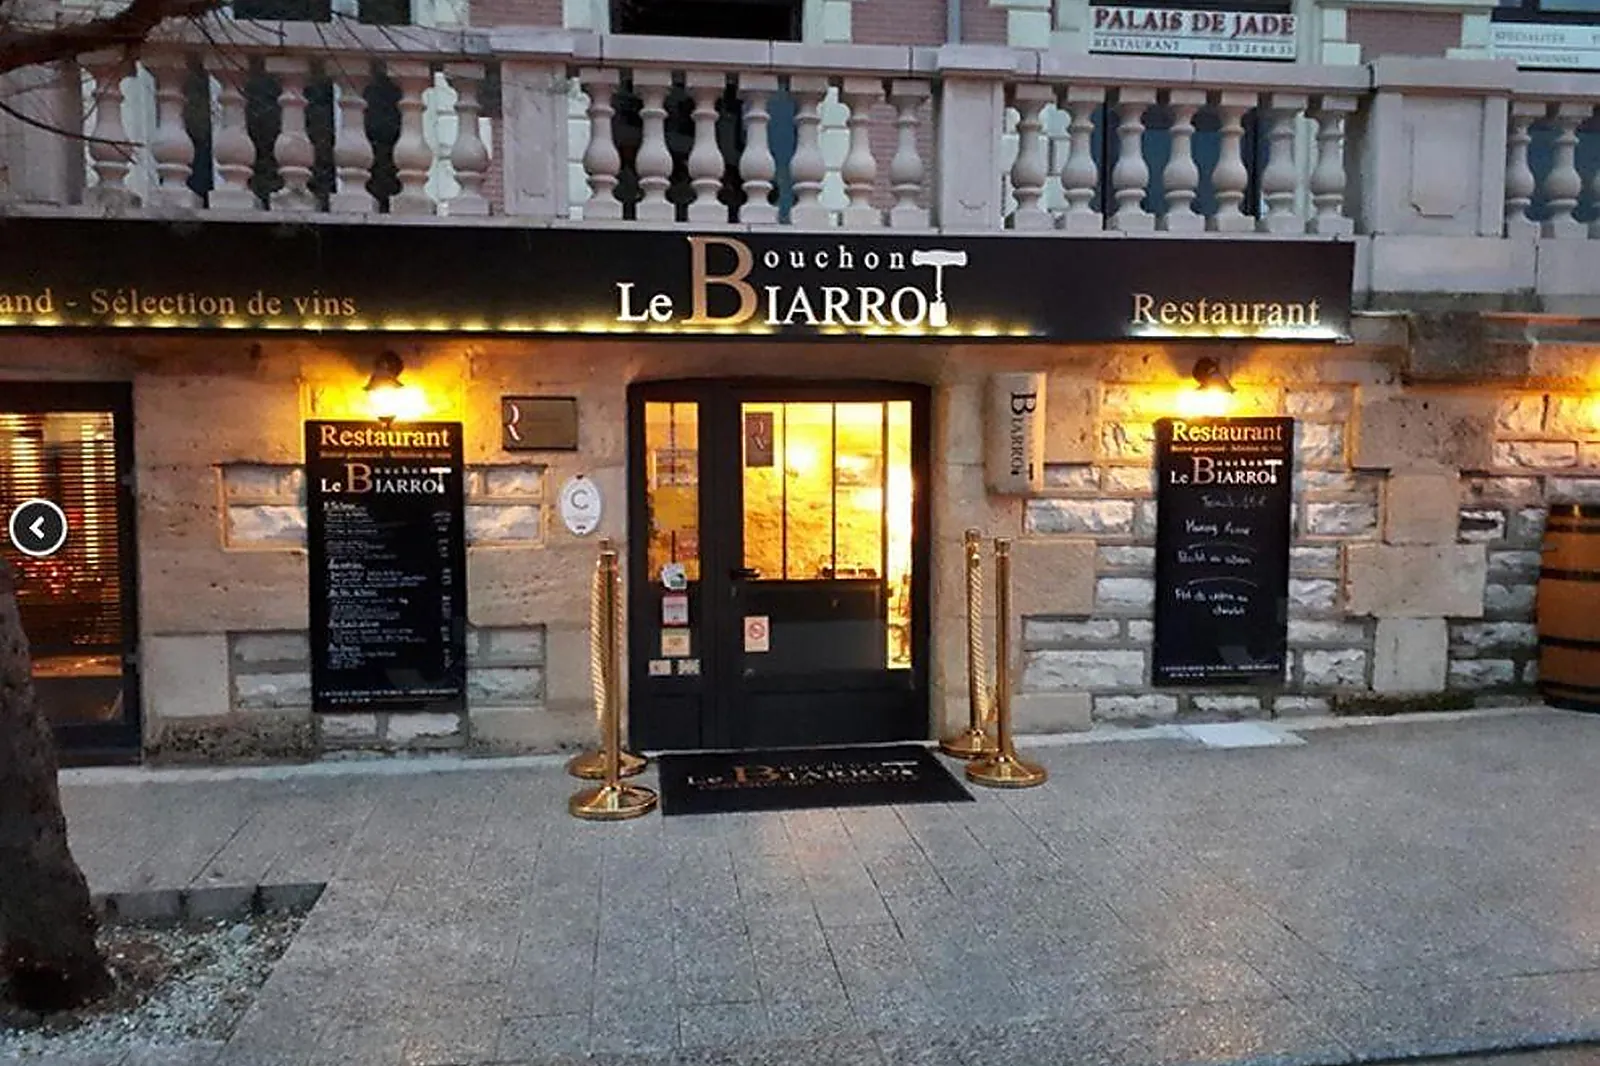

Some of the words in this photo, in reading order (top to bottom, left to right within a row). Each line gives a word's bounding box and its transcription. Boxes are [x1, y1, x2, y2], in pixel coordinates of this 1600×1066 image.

[1095, 8, 1183, 30] PALAIS
[1192, 13, 1225, 32] DE
[1231, 14, 1294, 39] JADE
[1094, 37, 1180, 51] RESTAURANT
[91, 288, 235, 316] Sélection
[249, 289, 281, 315] de
[294, 290, 356, 316] vins
[616, 282, 673, 322] Le
[1132, 293, 1320, 326] Restaurant
[320, 424, 450, 448] Restaurant
[1171, 420, 1283, 442] Restaurant
[321, 478, 342, 493] Le
[1170, 470, 1189, 484] Le
